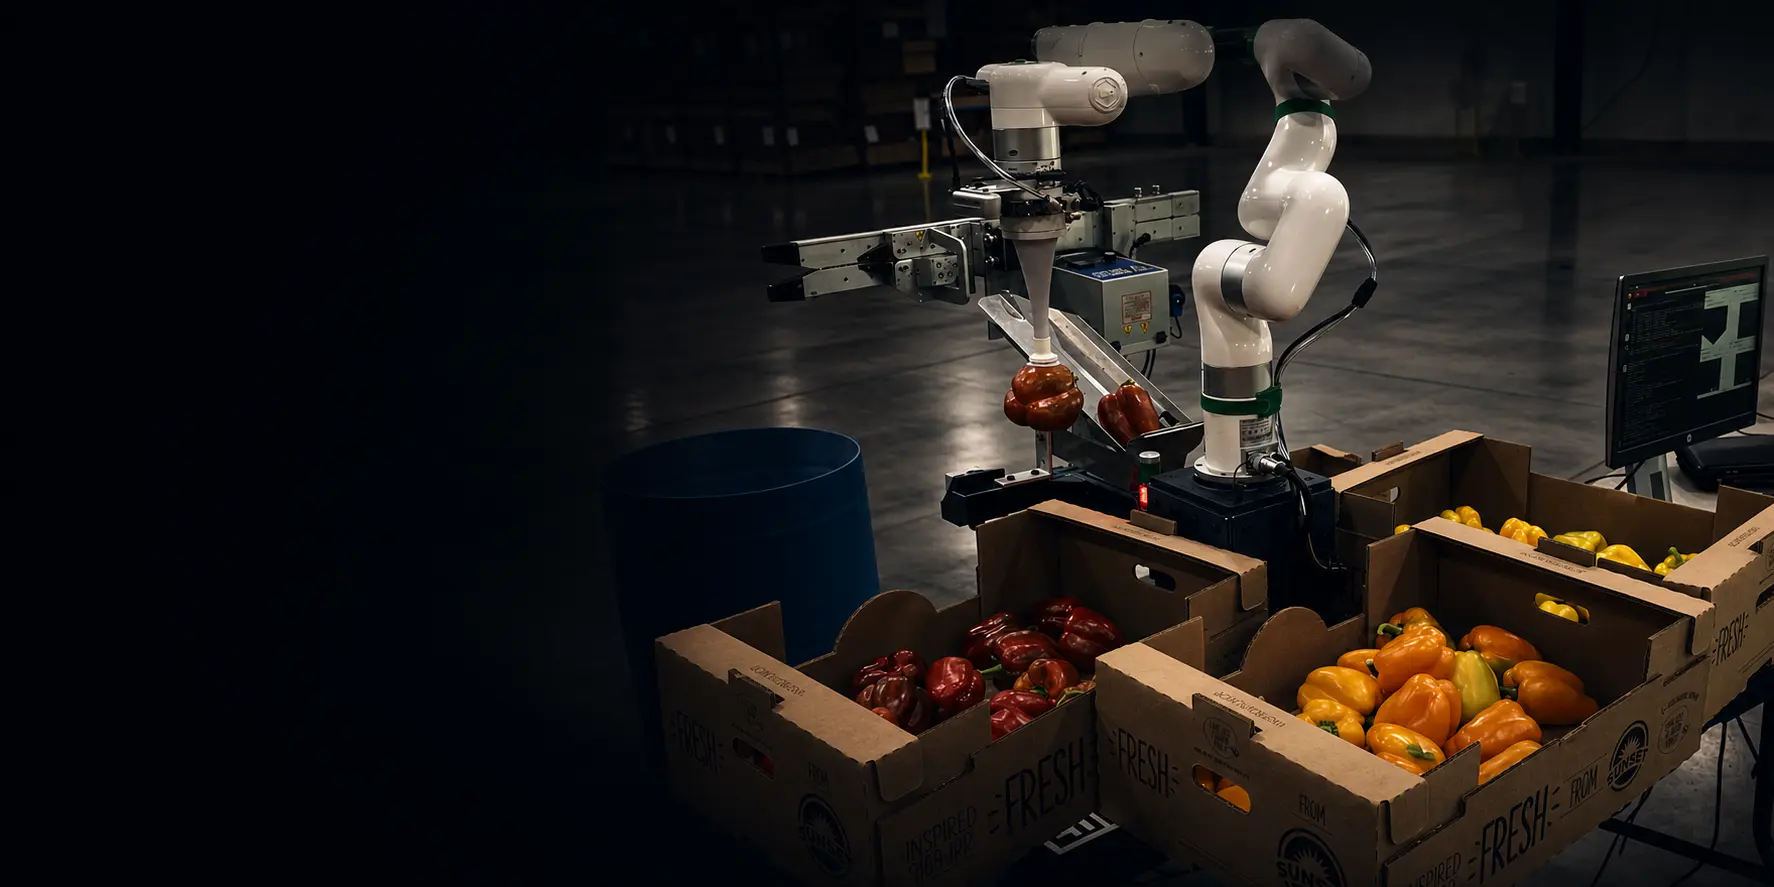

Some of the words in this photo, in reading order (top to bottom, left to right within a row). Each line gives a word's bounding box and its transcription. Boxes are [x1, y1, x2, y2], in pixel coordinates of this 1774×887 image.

[1716, 612, 1745, 666] FRESH
[676, 709, 718, 775] FRESH
[1118, 728, 1169, 798] FRESH
[1607, 747, 1649, 785] SUNSET
[1005, 737, 1085, 834] FRESH
[1300, 793, 1326, 826] FROM
[1569, 765, 1598, 808] FROM
[906, 805, 977, 862] INSPIRED
[1480, 785, 1548, 884] FRESH
[1409, 852, 1461, 887] SPIRED
